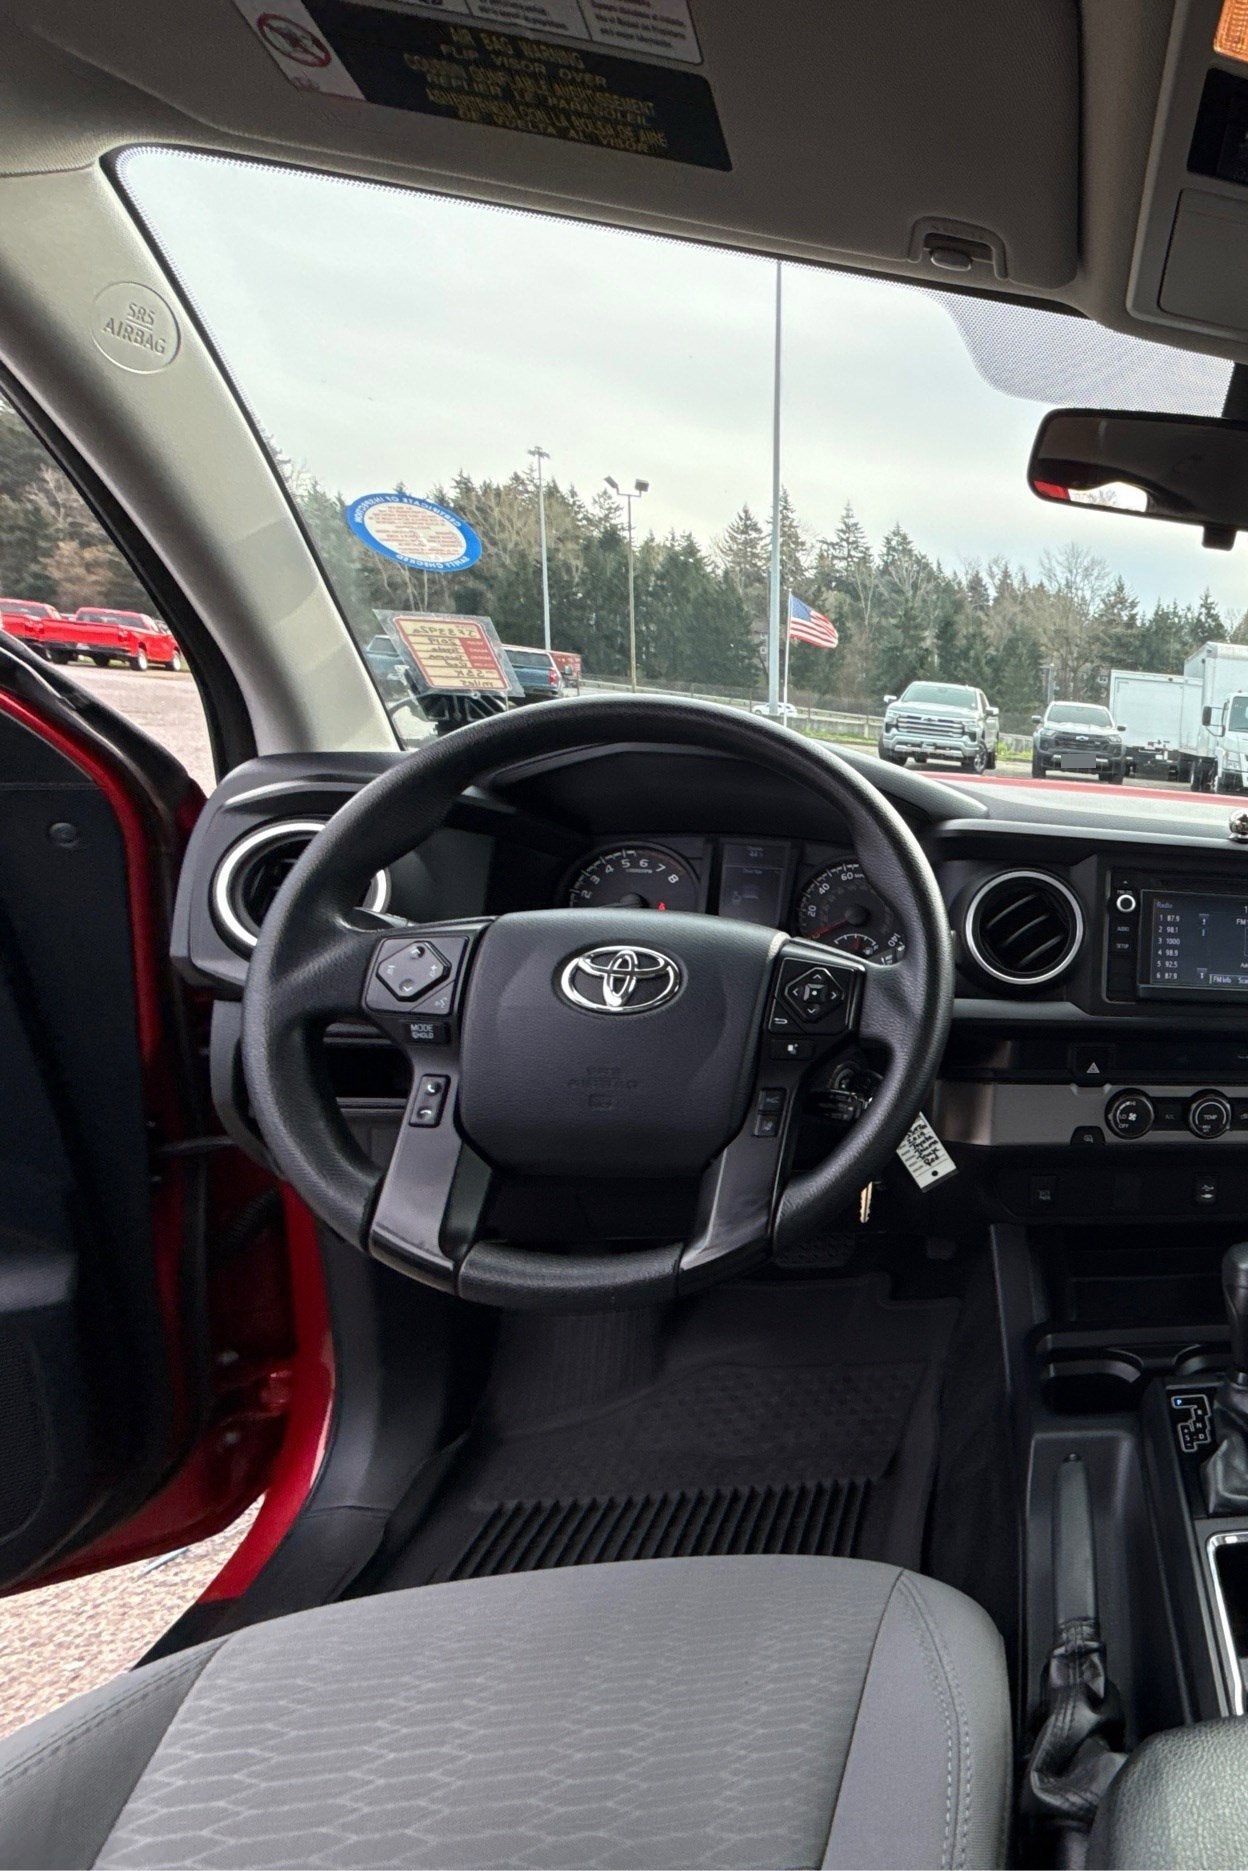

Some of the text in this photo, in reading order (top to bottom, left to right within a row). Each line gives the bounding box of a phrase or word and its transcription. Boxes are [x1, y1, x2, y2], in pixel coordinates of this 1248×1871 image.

[479, 31, 514, 55] BAG
[516, 38, 586, 69] WARNING
[490, 53, 547, 75] VISOR
[558, 67, 607, 89] OVER
[127, 302, 157, 324] SRS
[103, 318, 167, 355] AIRBAG
[590, 875, 601, 885] 3
[605, 864, 615, 873] 4
[621, 859, 631, 868] 5
[638, 858, 650, 868] 6
[656, 863, 667, 872] 7
[668, 873, 680, 884] 8
[807, 904, 817, 918] 20
[818, 883, 830, 895] 40
[841, 872, 854, 881] 60
[1166, 926, 1178, 934] 98.1
[1236, 918, 1247, 926] FM
[1165, 961, 1178, 969] 92.5
[410, 1023, 434, 1032] MODE
[1203, 1113, 1218, 1121] TEMP
